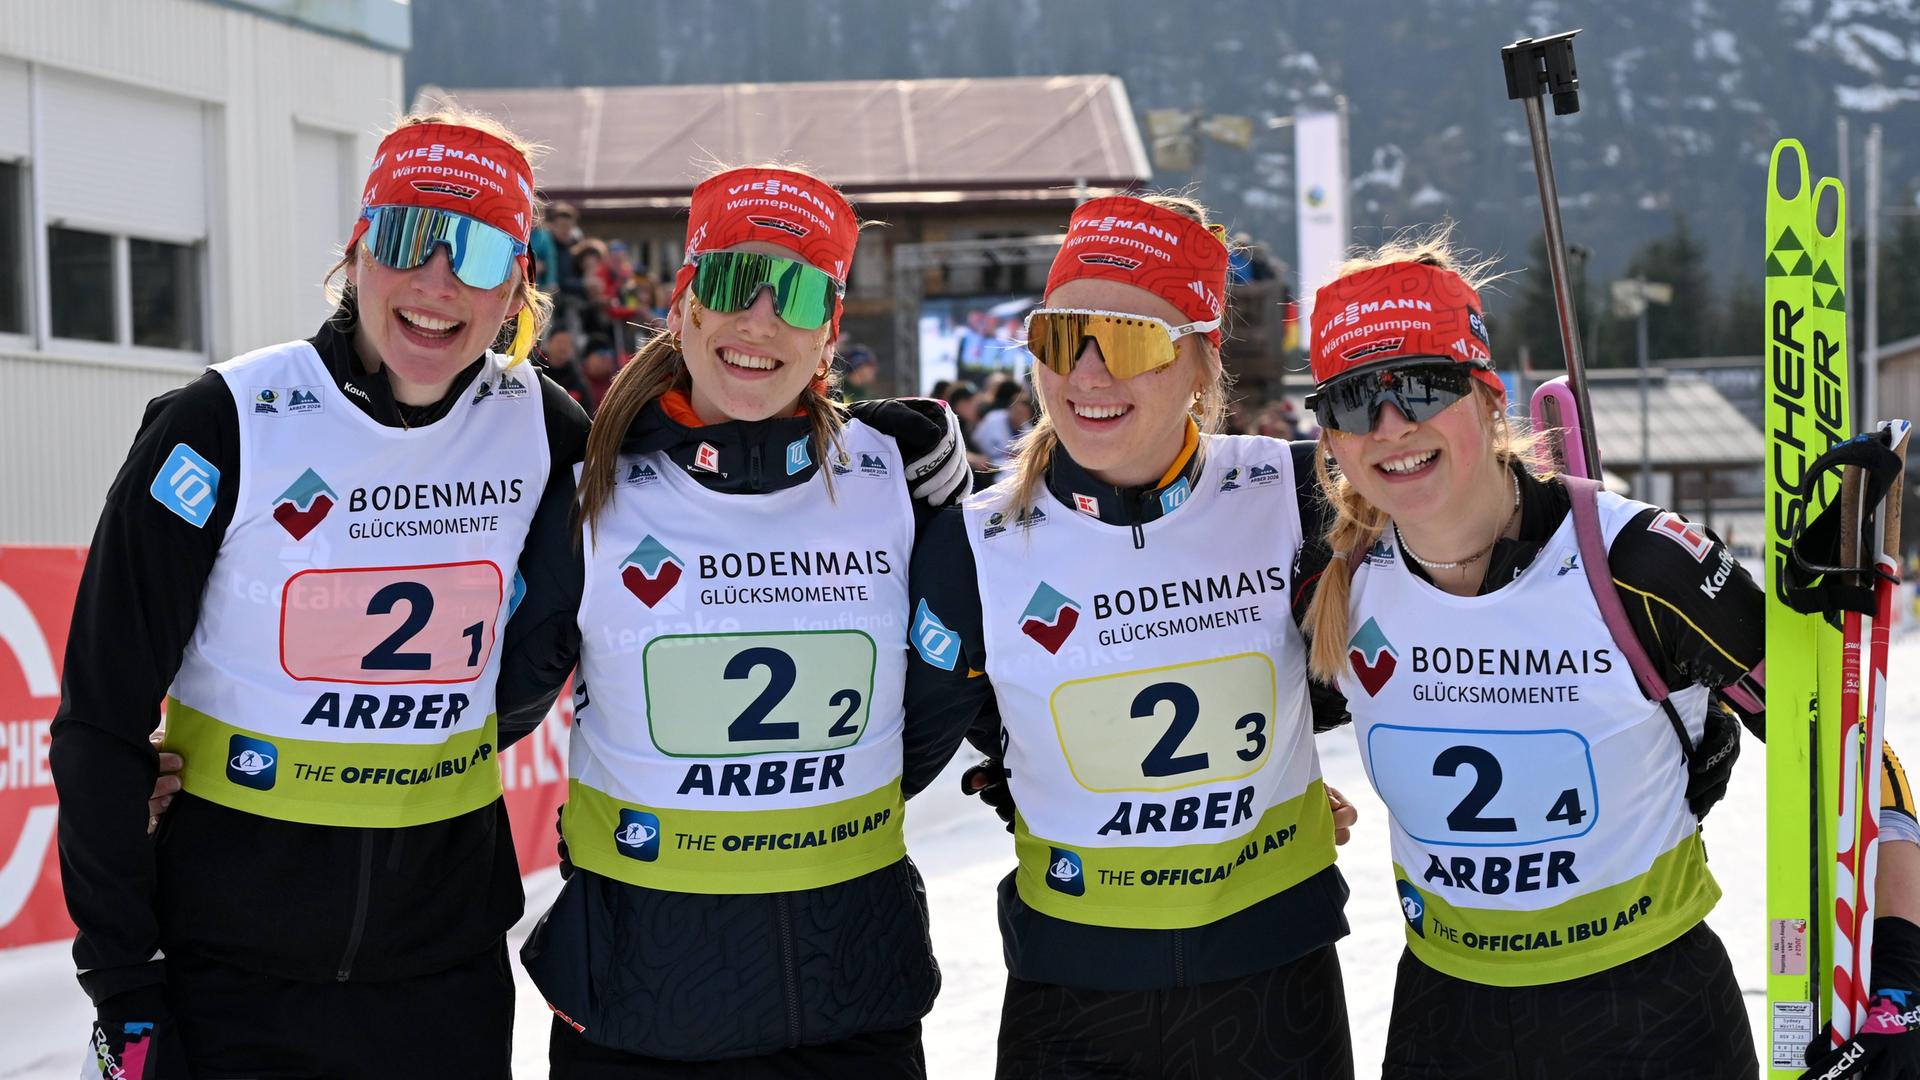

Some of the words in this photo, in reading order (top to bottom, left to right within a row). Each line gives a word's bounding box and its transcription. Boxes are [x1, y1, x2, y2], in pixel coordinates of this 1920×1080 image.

[392, 165, 504, 195] Wärmepumpen
[395, 143, 507, 179] VIESSMANN
[726, 198, 831, 235] Wärmepumpen
[728, 179, 836, 221] VIESSMANN
[1066, 234, 1171, 262] Wärmepumpen
[1073, 216, 1179, 247] VIESSMANN
[1320, 299, 1432, 339] VIESSMANN
[1321, 319, 1431, 359] Wärmepumpen
[1814, 330, 1843, 510] CHER
[349, 478, 523, 512] BODENMAIS
[349, 515, 498, 539] GLÜCKSMOMENTE
[699, 550, 891, 579] BODENMAIS
[700, 584, 868, 605] GLÜCKSMOMENTE
[1094, 566, 1285, 620] BODENMAIS
[360, 582, 434, 670] 2
[462, 620, 485, 667] 1
[1099, 605, 1262, 647] GLÜCKSMOMENTE
[1412, 646, 1612, 675] BODENMAIS
[301, 692, 470, 729] ARBER
[723, 647, 799, 741] 2
[828, 689, 861, 738] 2
[1413, 683, 1580, 704] GLÜCKSMOMENTE
[1130, 682, 1209, 777] 2
[1235, 712, 1266, 761] 3
[294, 762, 335, 783] THE
[341, 767, 433, 785] OFFICIAL
[435, 757, 467, 779] IBU
[468, 743, 492, 769] PP
[676, 754, 845, 796] ARBER
[1433, 745, 1517, 832] 2
[1546, 788, 1587, 826] 4
[675, 833, 716, 851] THE
[722, 830, 827, 852] OFFICIAL
[831, 820, 859, 843] IBU
[862, 808, 890, 833] APP
[1097, 785, 1255, 836] ARBER
[1098, 870, 1134, 886] THE
[1233, 841, 1258, 869] BU
[1263, 824, 1297, 854] APP
[1424, 850, 1580, 895] ARBER
[1433, 918, 1459, 944] THE
[1462, 931, 1562, 952] OFFICIAL
[1568, 918, 1608, 943] IBU
[1613, 895, 1653, 932] APP
